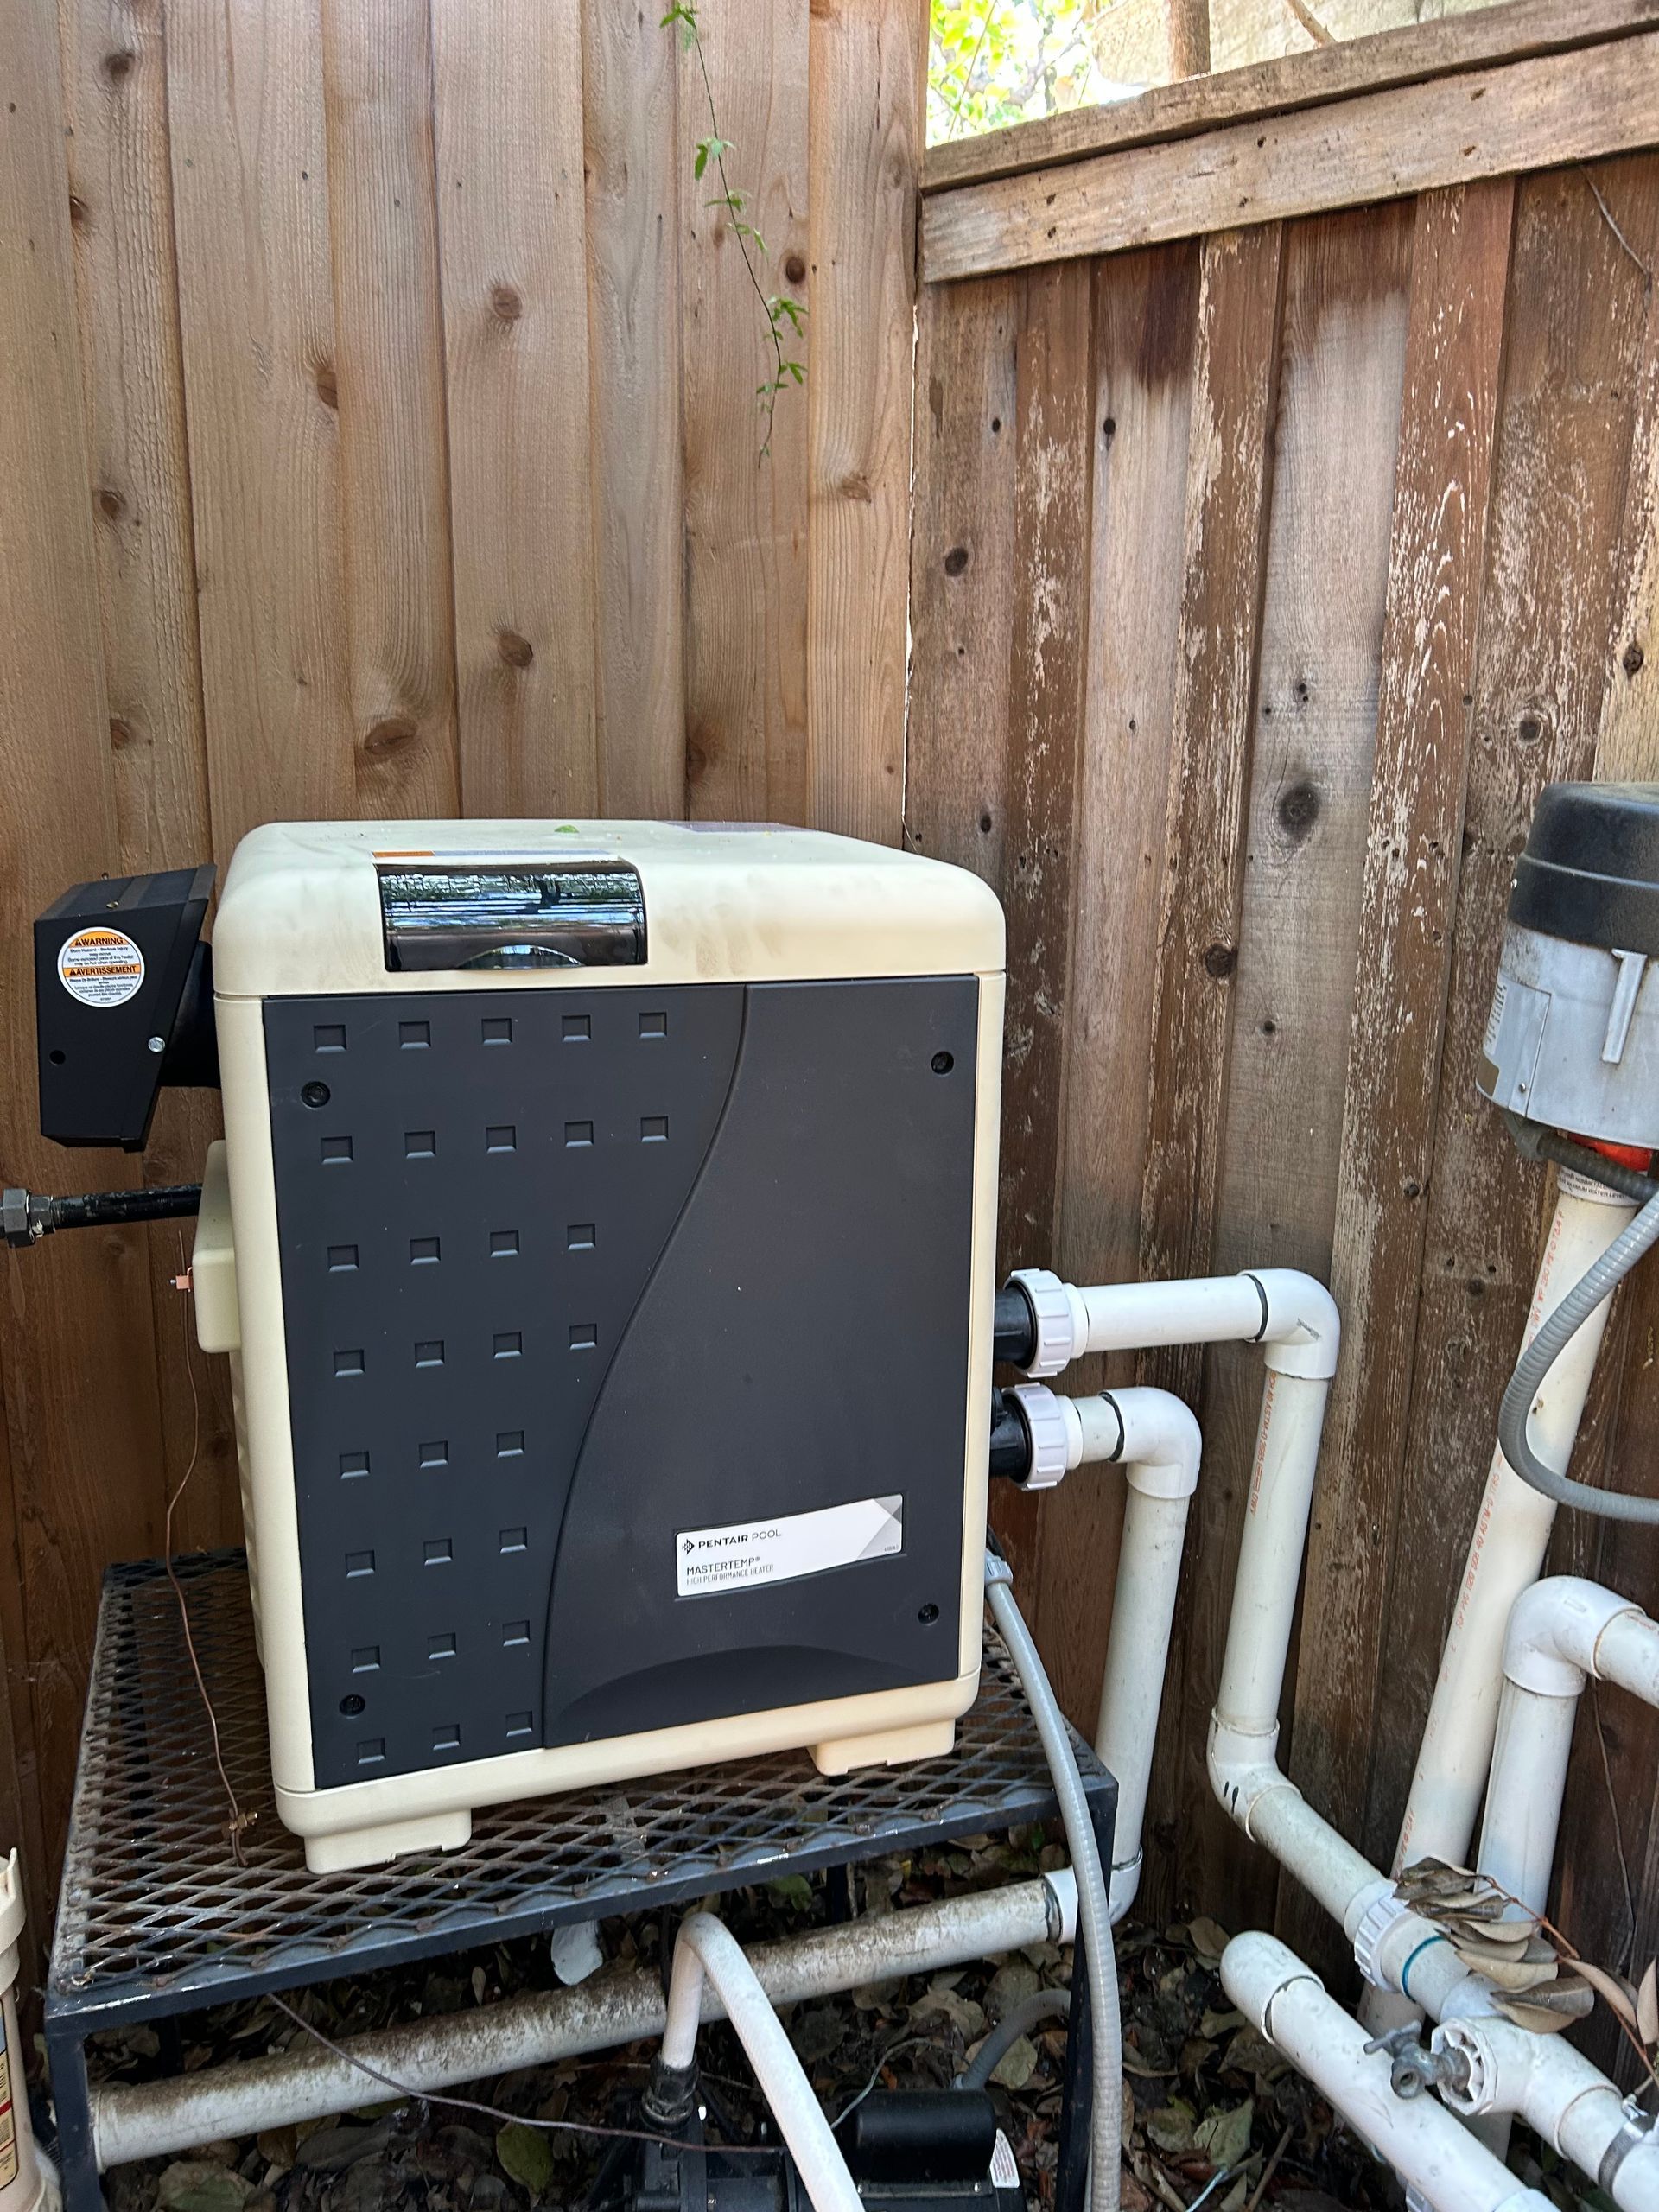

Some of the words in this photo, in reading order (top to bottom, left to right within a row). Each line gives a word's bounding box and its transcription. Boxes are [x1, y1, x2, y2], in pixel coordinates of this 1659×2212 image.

[81, 938, 124, 946] WARNING
[75, 966, 137, 976] AVERTISSEMENT
[698, 1535, 748, 1549] PENTAIR
[752, 1529, 782, 1541] POOL
[686, 1576, 702, 1586] HIGH
[703, 1569, 749, 1584] PERFORMANCE
[750, 1564, 774, 1578] HEATER
